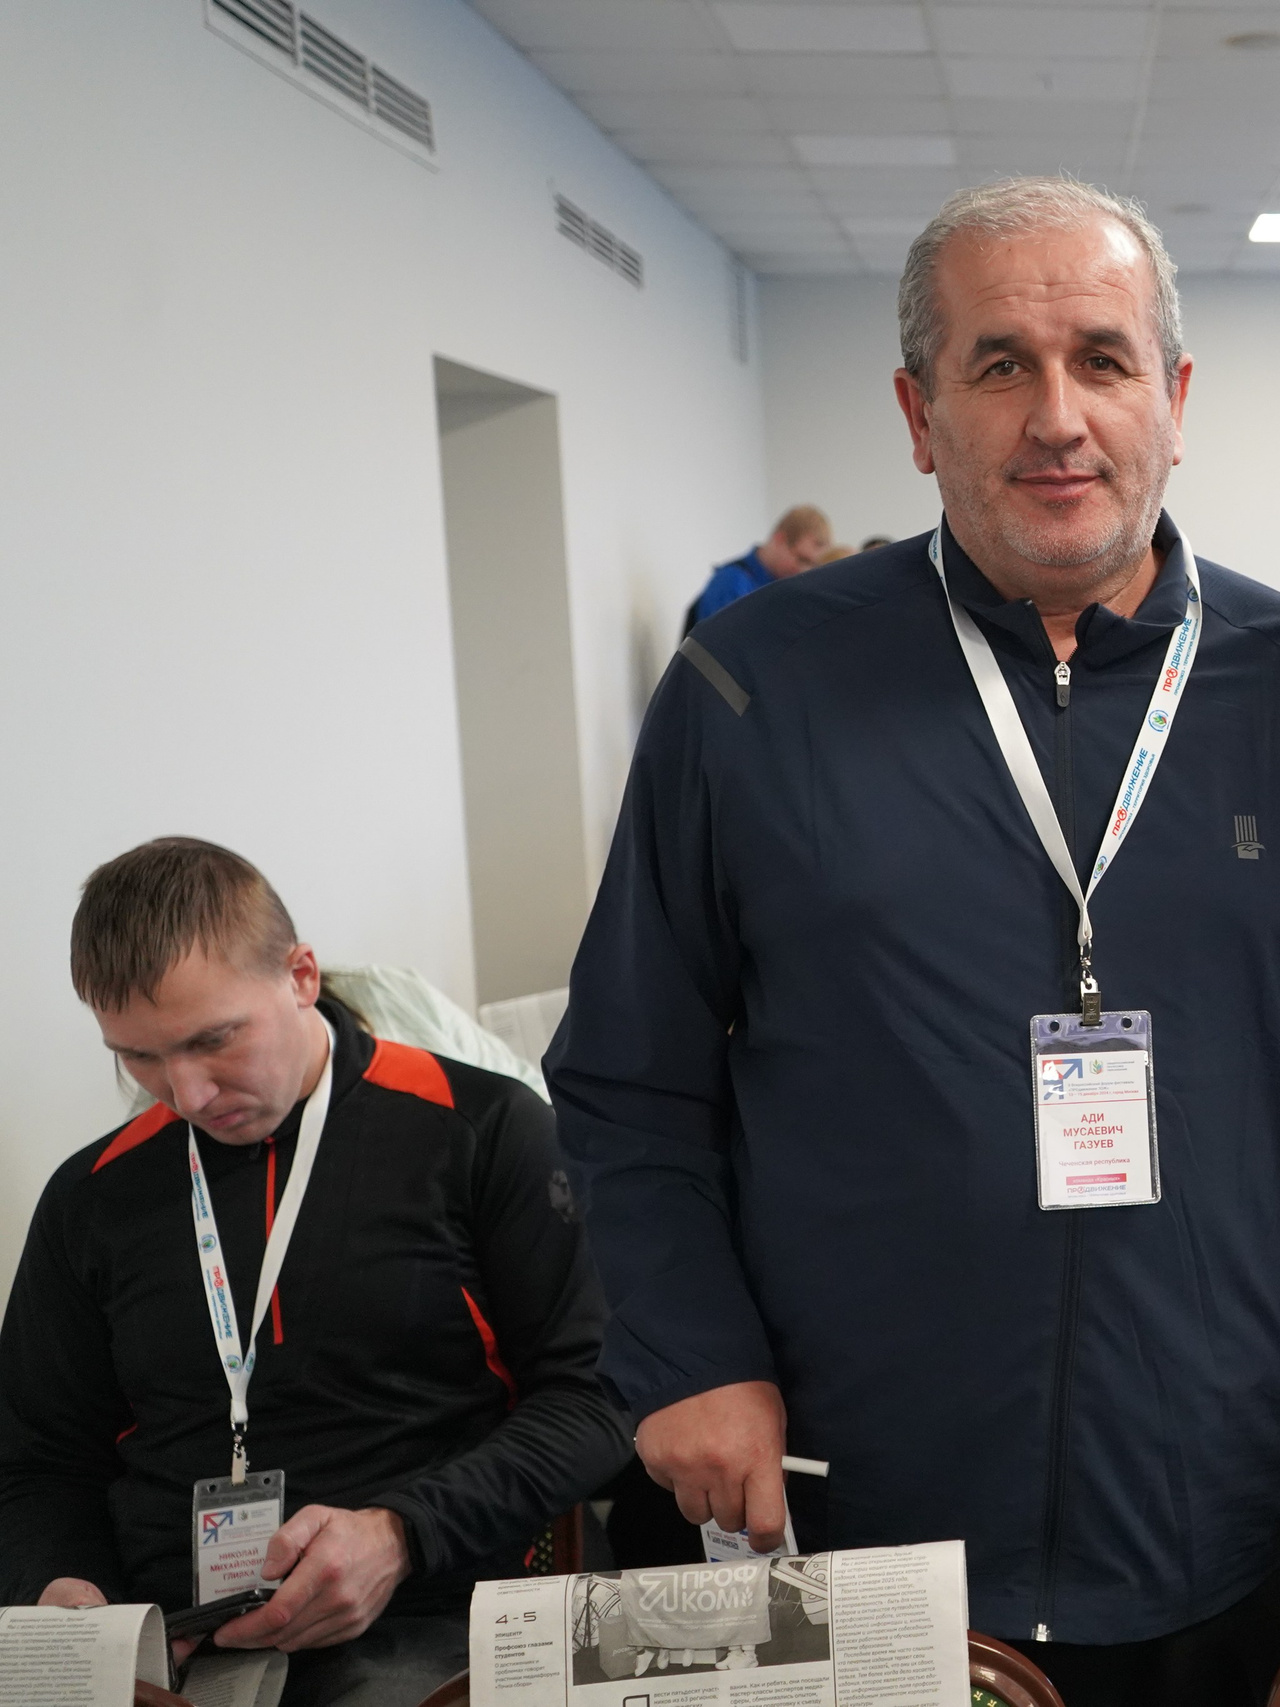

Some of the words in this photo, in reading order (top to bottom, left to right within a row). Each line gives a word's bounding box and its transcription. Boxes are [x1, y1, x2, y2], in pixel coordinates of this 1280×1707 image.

[1162, 618, 1192, 692] ПРОДВИЖЕНИЕ
[1174, 670, 1186, 696] ПРОФСОЮЗ
[1184, 641, 1194, 667] ТЕРРИТОРИЯ
[1132, 778, 1146, 809] ТЕРРИТОРИЯ
[1144, 754, 1156, 778] ЗДОРОВЬЯ
[1112, 747, 1148, 836] ПРОДВИЖЕНИЕ
[1080, 1112, 1105, 1123] АДИ
[1063, 1125, 1123, 1137] МУСАЕВИЧ
[1074, 1139, 1114, 1150] ГАЗУЕВ
[1094, 1156, 1130, 1167] республика
[219, 1547, 258, 1560] НИКОЛАЙ
[682, 1564, 758, 1588] ПРОФ
[682, 1587, 739, 1612] КОМ
[495, 1614, 508, 1624] 4
[523, 1611, 537, 1622] 5
[495, 1630, 522, 1638] ЭПИЦЕНТР
[495, 1642, 526, 1652] Профсоюз
[844, 1650, 870, 1658] Последнее
